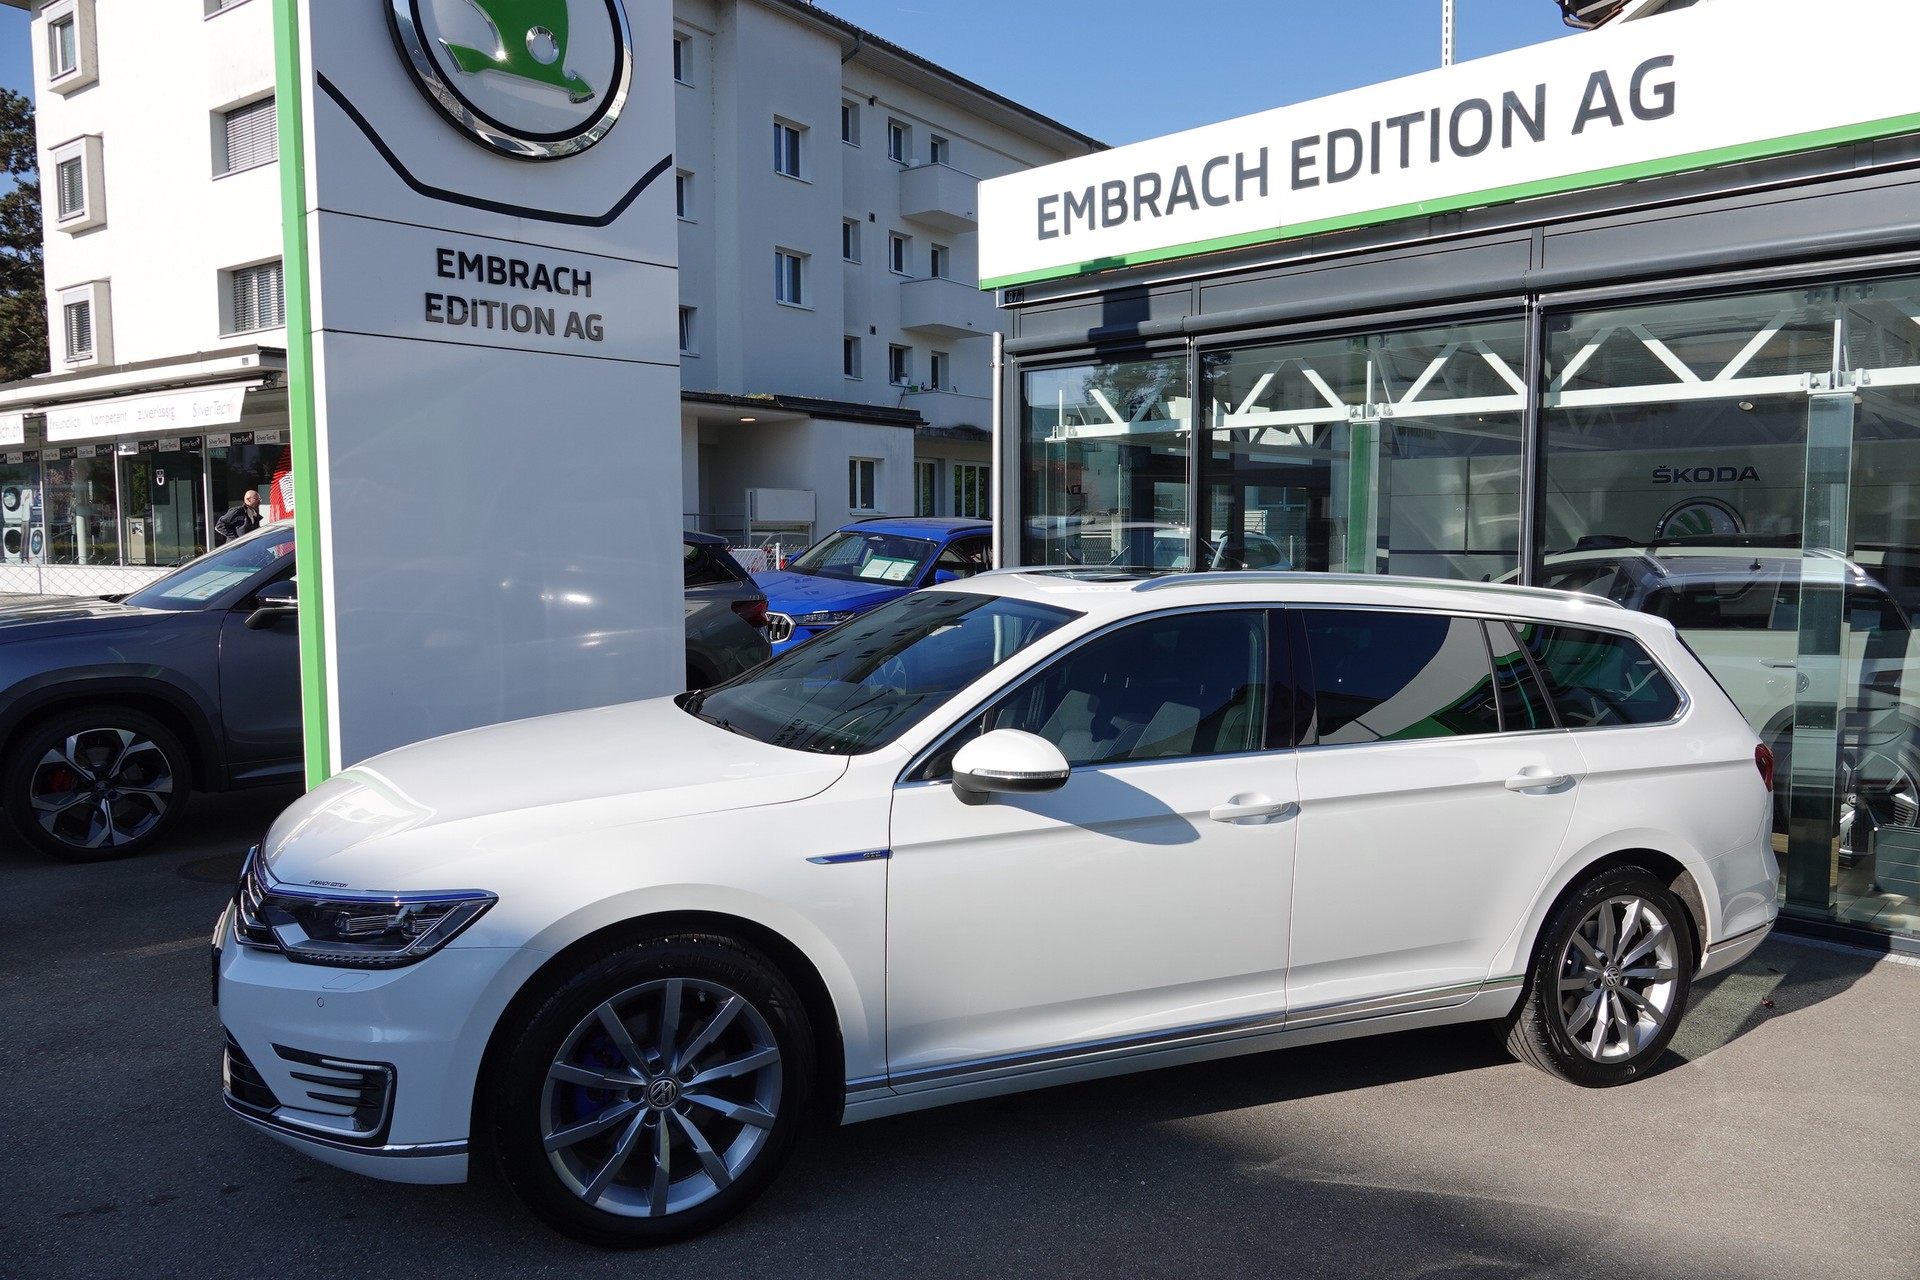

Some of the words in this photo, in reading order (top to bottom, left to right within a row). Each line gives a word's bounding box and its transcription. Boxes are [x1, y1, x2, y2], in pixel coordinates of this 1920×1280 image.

[1037, 146, 1269, 241] EMBRACH
[1291, 82, 1546, 192] EDITION
[1571, 54, 1676, 136] AG
[436, 248, 592, 298] EMBRACH
[1008, 291, 1019, 303] 87
[425, 292, 556, 336] EDITION
[563, 310, 604, 342] AG
[91, 412, 127, 426] kompetent
[1652, 465, 1761, 484] ŠKODA
